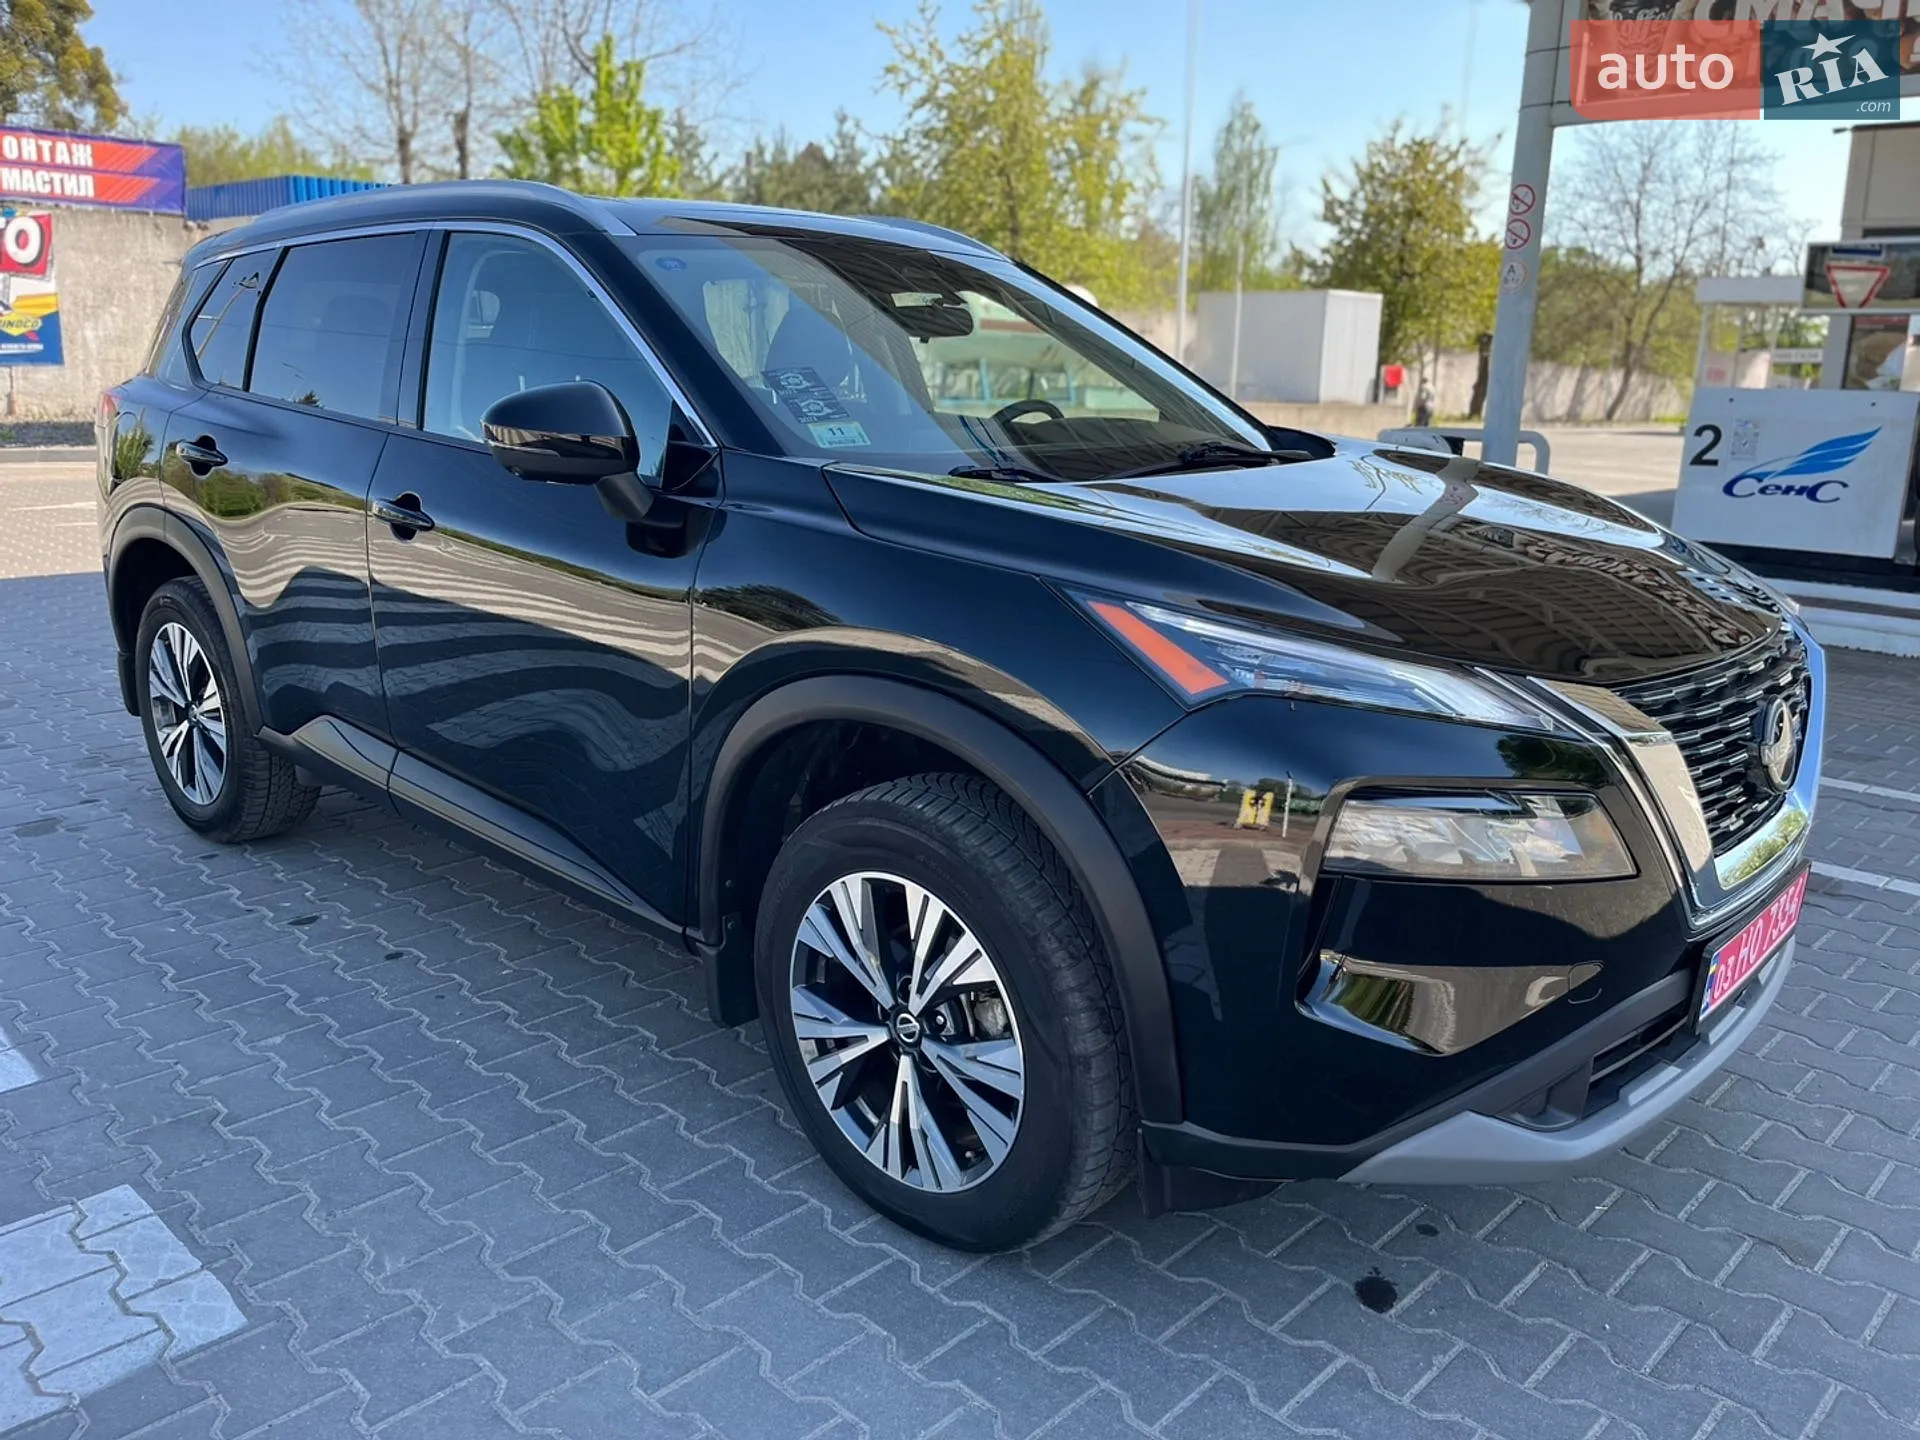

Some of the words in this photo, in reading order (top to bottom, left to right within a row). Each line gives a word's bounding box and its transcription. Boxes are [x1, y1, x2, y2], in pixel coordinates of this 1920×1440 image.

[2, 135, 94, 169] ОНТАЖ
[0, 167, 95, 198] МАСТИЛ
[1689, 424, 1723, 466] 2
[1734, 918, 1764, 981] HO
